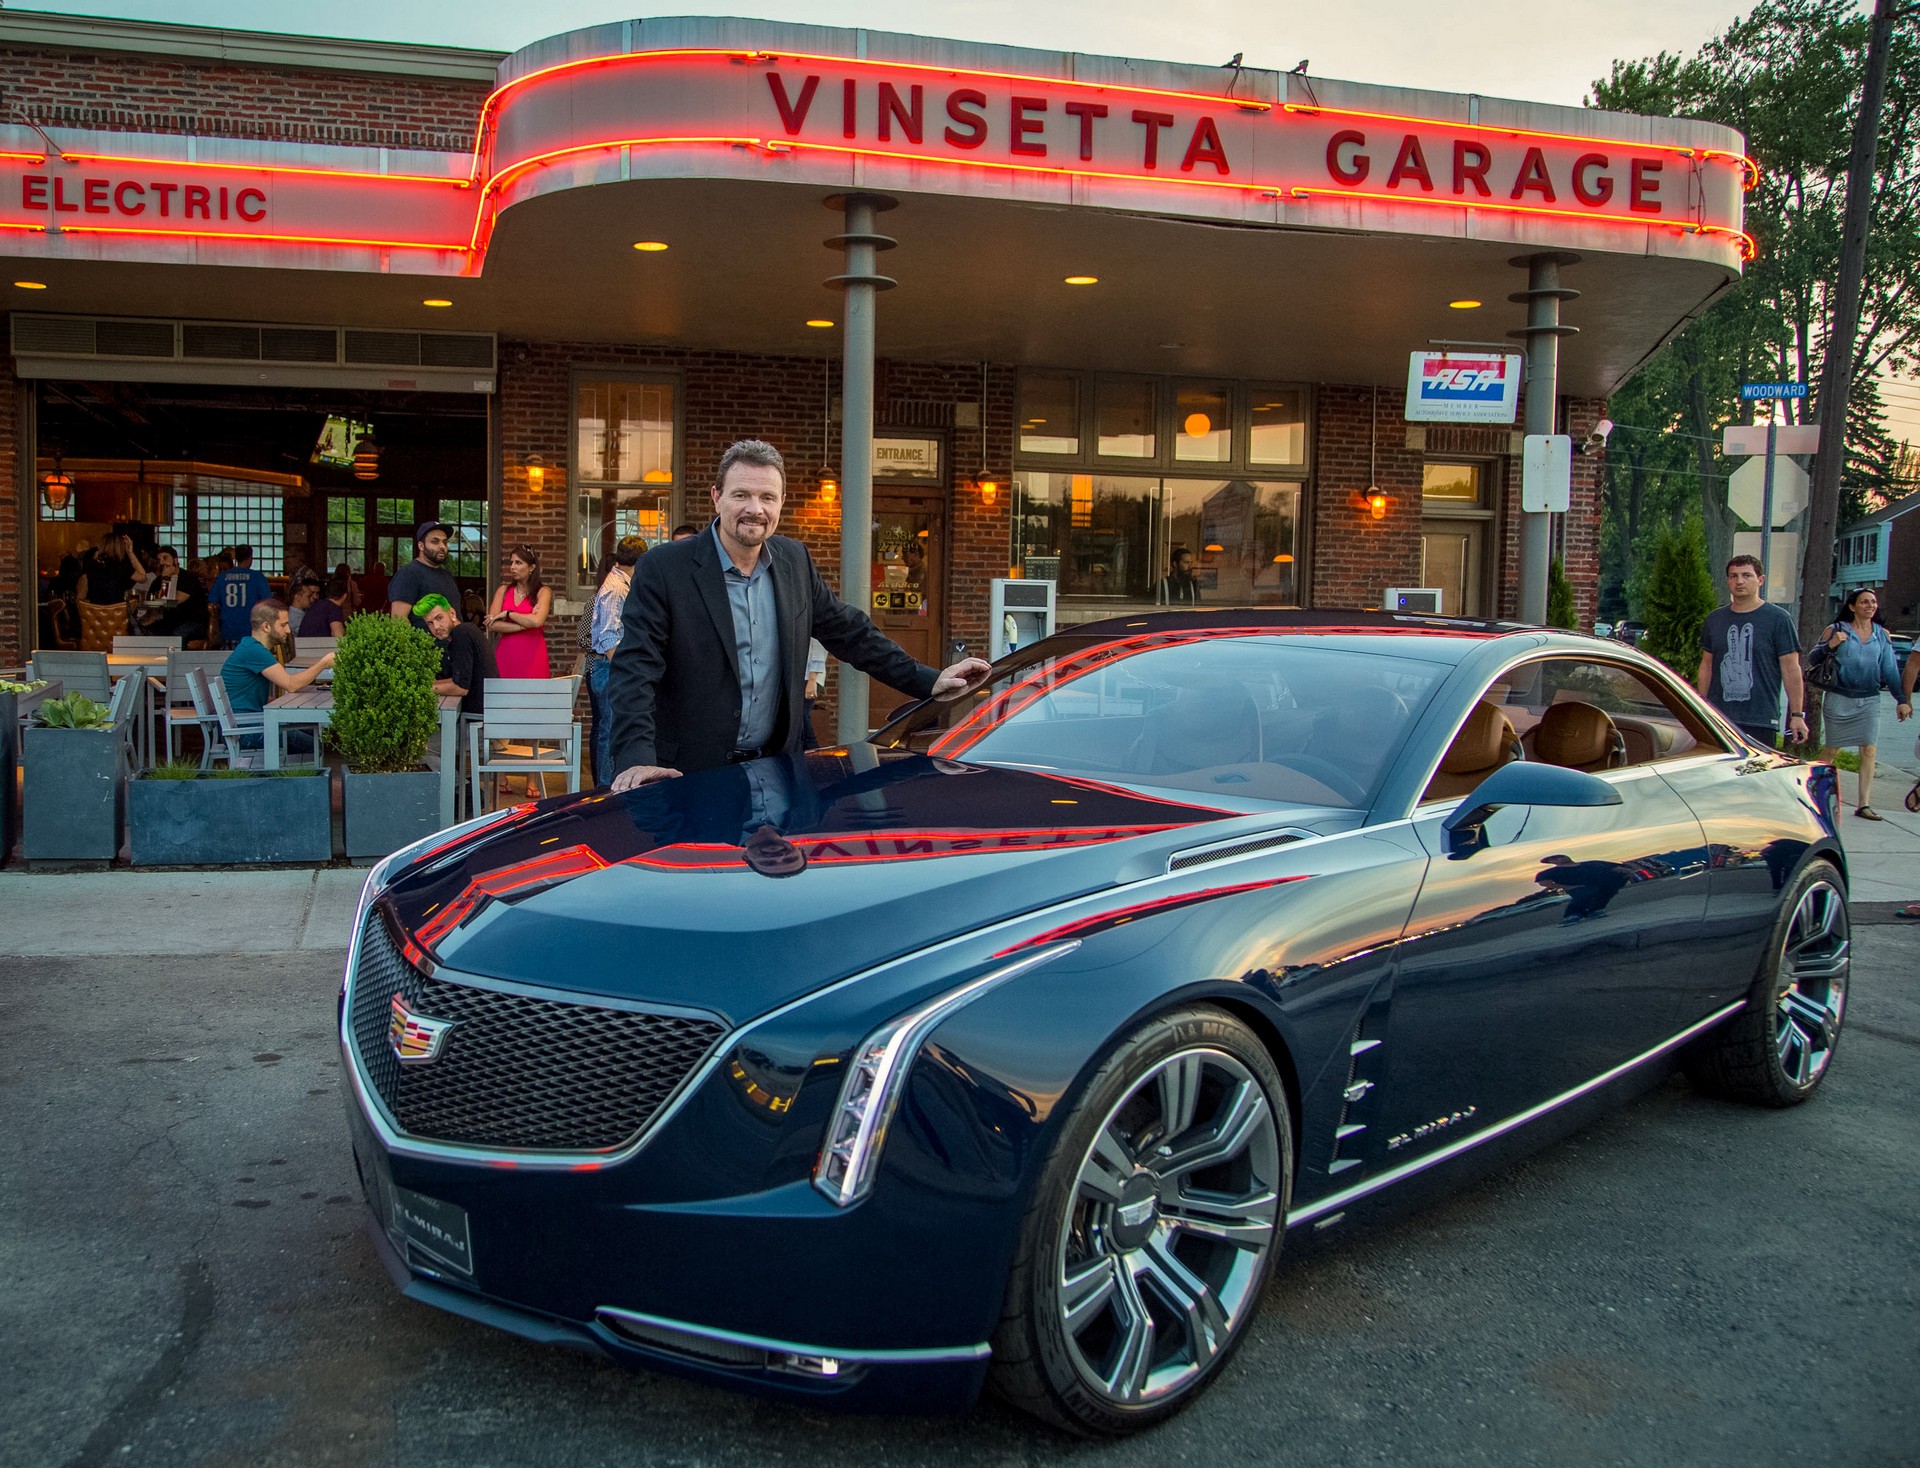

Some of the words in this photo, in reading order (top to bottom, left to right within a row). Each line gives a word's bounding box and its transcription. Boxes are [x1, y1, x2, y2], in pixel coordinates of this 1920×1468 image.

[765, 71, 1230, 175] VINSETTA
[1327, 129, 1664, 213] GARAGE
[20, 174, 267, 222] ELECTRIC
[1427, 368, 1499, 391] ASA
[1744, 384, 1806, 397] WOODWARD
[876, 447, 923, 460] ENTRANCE
[225, 582, 247, 608] 81
